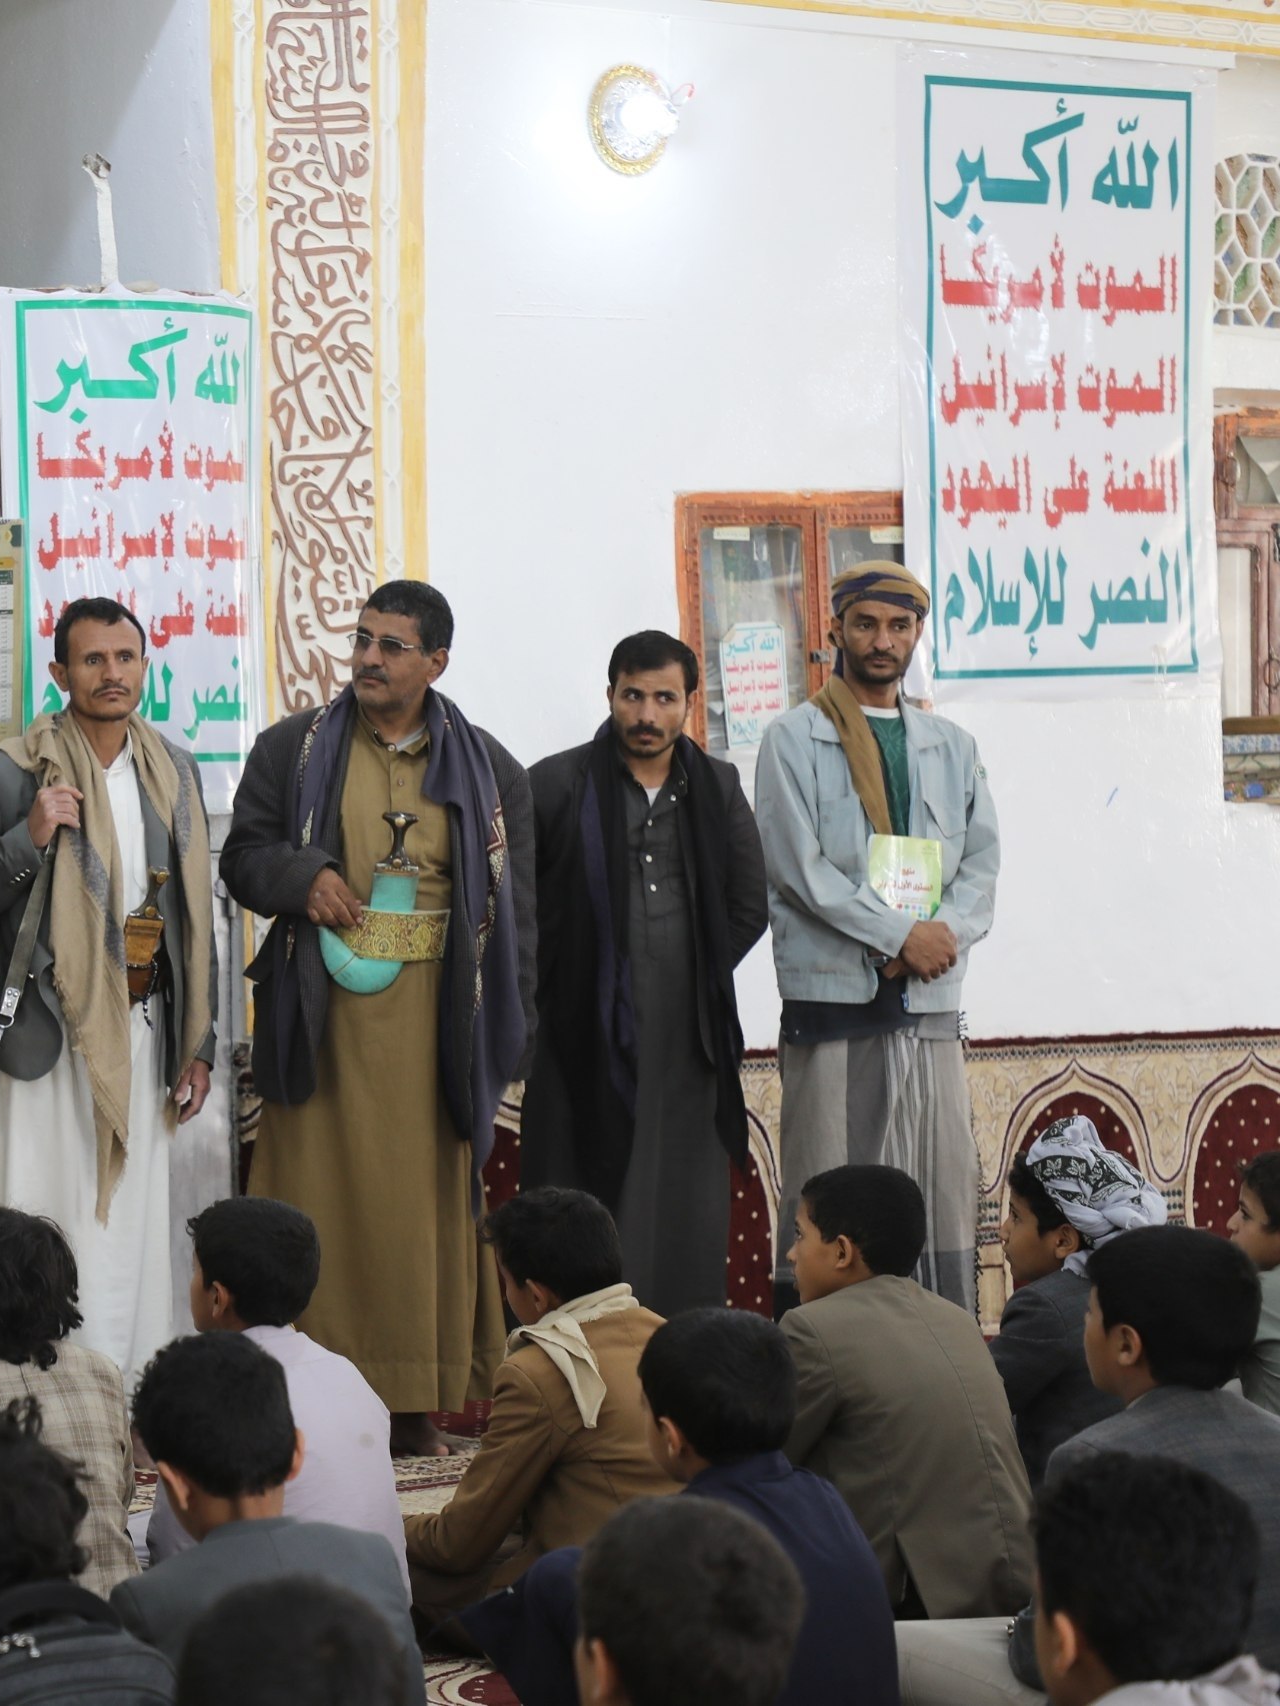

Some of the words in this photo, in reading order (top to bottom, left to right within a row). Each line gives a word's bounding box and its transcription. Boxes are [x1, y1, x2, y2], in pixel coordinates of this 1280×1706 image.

[933, 97, 1085, 236] أكبر
[1091, 114, 1179, 213] الله
[939, 231, 1067, 325] لأمريكا
[1076, 251, 1177, 327] الموت
[33, 316, 189, 425] أكبر
[939, 343, 1067, 431] لإسرائيل
[1077, 351, 1178, 429] الموت
[36, 419, 175, 491] لأمريكا
[940, 450, 1033, 531] اليهود
[1043, 453, 1089, 530] على
[1103, 450, 1179, 516] اللعنة
[37, 506, 176, 572] لإسرائيل
[150, 588, 195, 649] على
[943, 545, 1068, 661] للإسلام
[1078, 536, 1183, 651] النصر
[760, 632, 780, 651] الله
